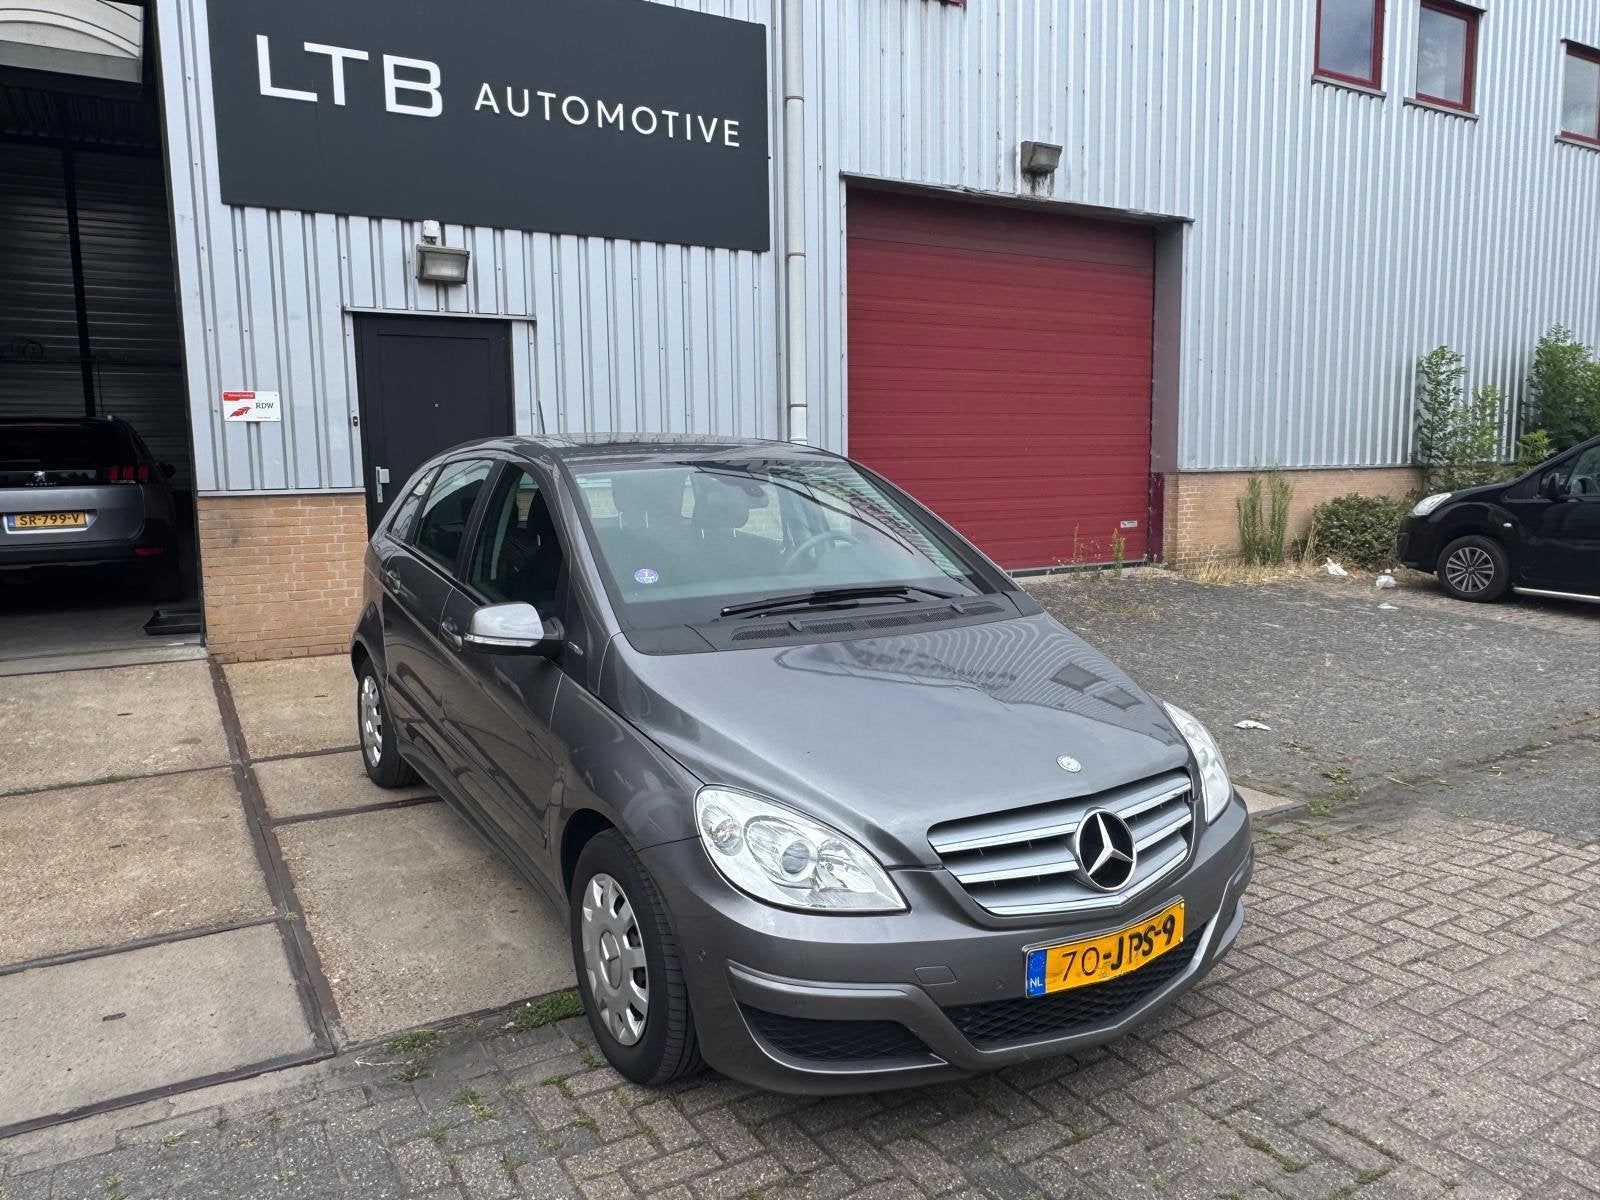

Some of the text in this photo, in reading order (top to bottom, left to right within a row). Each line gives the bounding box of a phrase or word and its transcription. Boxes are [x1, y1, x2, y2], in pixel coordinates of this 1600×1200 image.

[256, 34, 741, 148] LTB AUTOMOTIVE
[19, 513, 79, 526] SR-799-V
[1061, 914, 1176, 982] 70-JPS-9
[1029, 979, 1043, 988] NL
